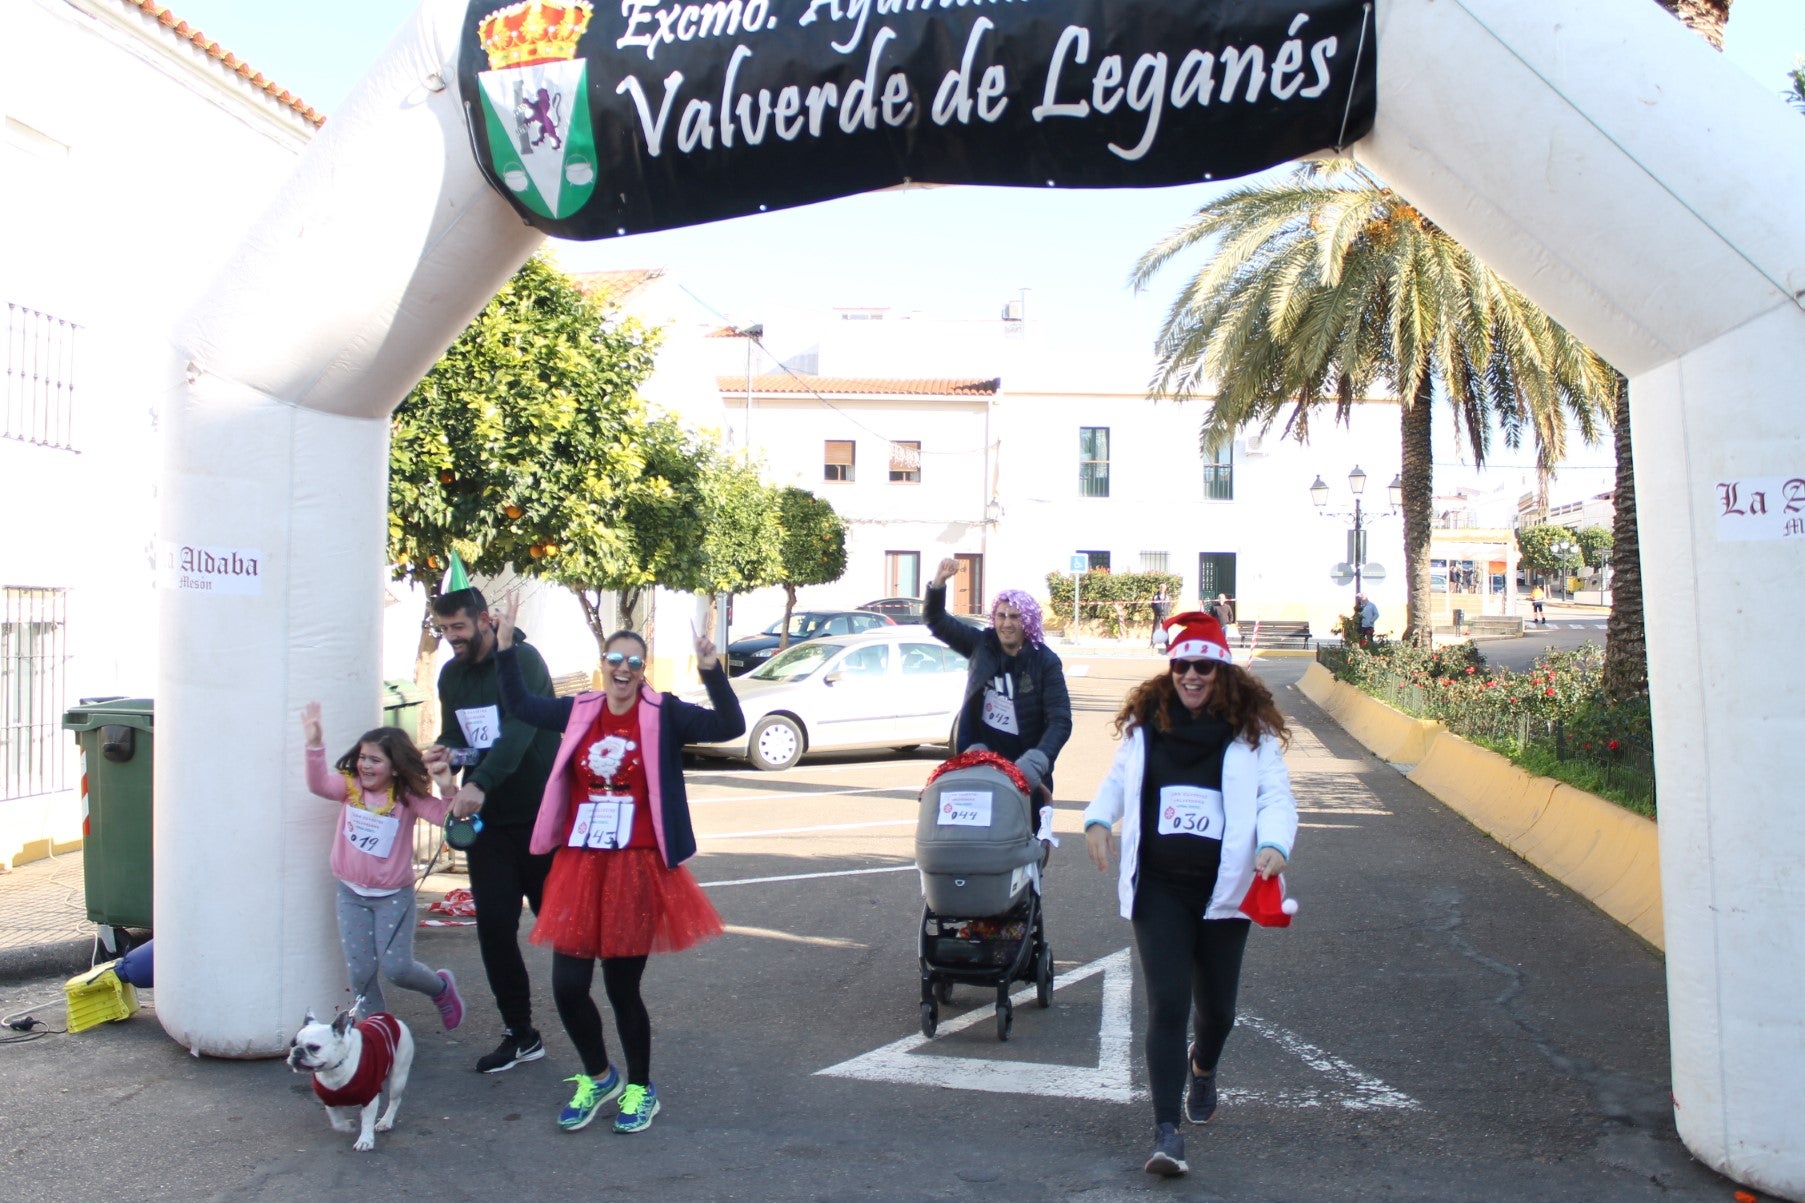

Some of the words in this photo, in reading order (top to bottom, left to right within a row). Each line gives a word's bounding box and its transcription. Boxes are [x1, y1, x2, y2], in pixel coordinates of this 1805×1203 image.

[616, 26, 913, 157] Valverde
[931, 16, 1008, 126] de
[1032, 12, 1337, 161] Leganés
[1716, 482, 1768, 516] La
[180, 546, 259, 577] Aldaba
[1173, 813, 1210, 832] 030
